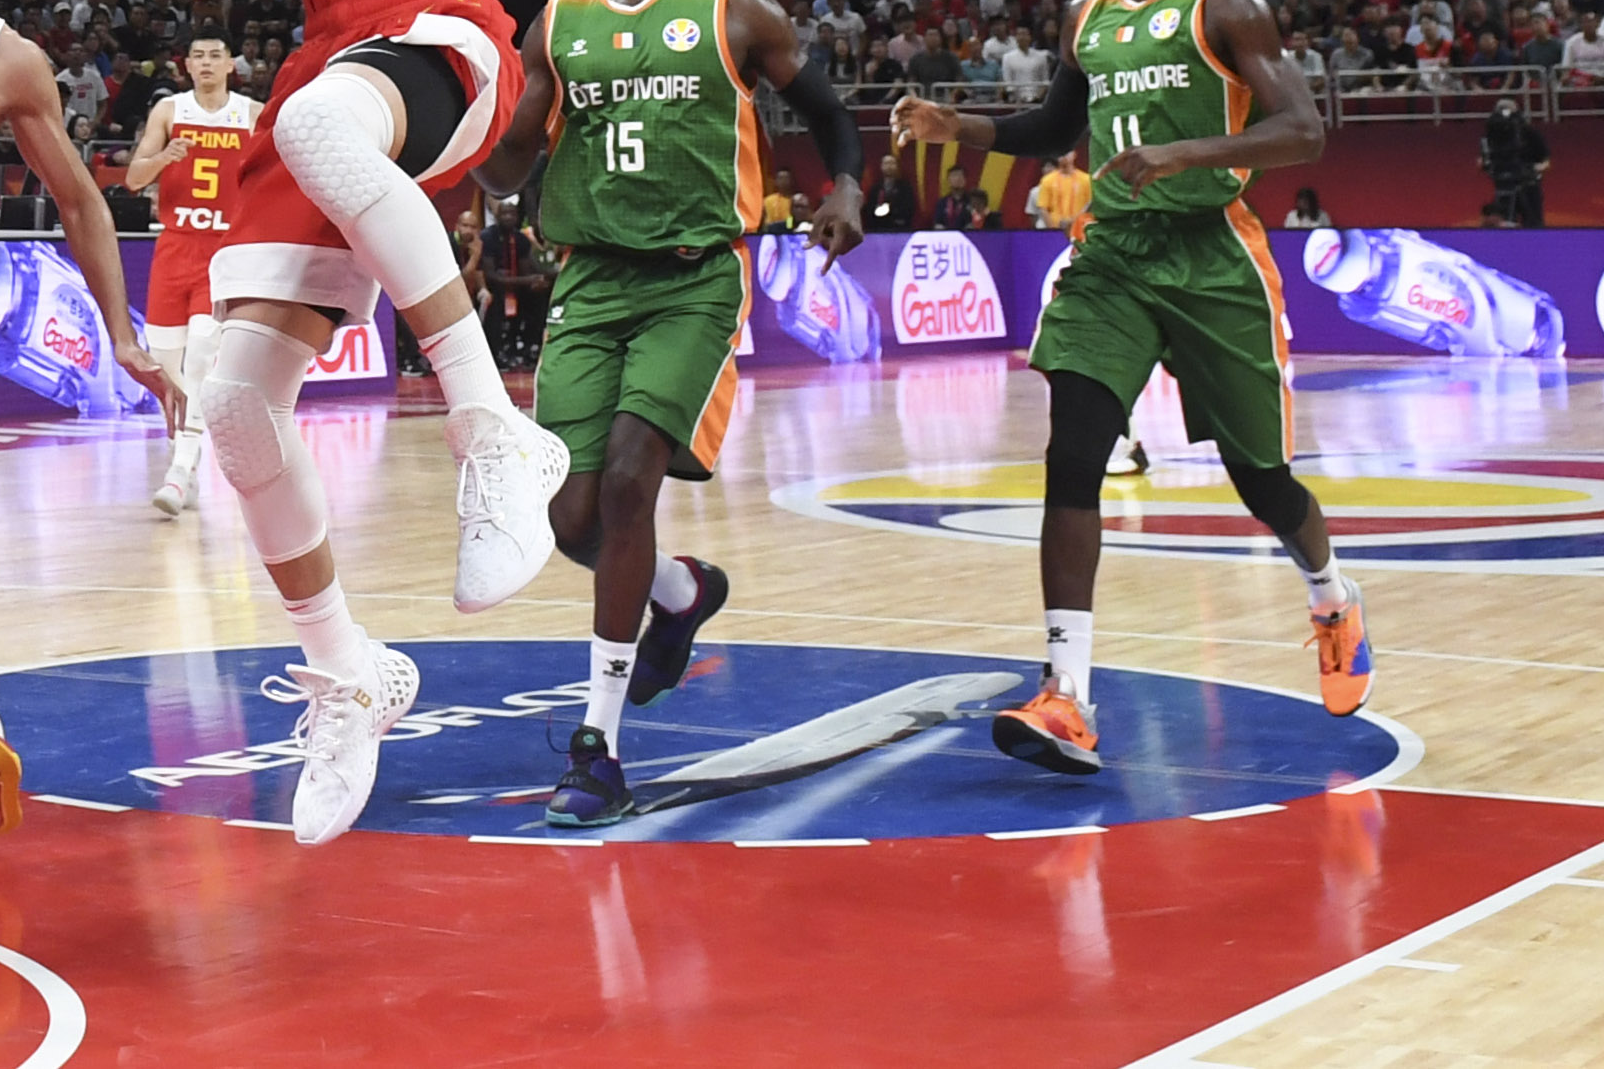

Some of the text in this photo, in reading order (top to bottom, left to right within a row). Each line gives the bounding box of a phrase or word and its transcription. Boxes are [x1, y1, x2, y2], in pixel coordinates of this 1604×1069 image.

[568, 75, 701, 109] ÔTE D'IVOIRE
[606, 121, 645, 173] 15
[1112, 114, 1142, 153] 11
[192, 158, 220, 200] 5
[174, 206, 230, 231] TCL
[911, 241, 971, 281] 百岁山
[901, 281, 995, 337] Ganten
[43, 317, 93, 371] Ganten
